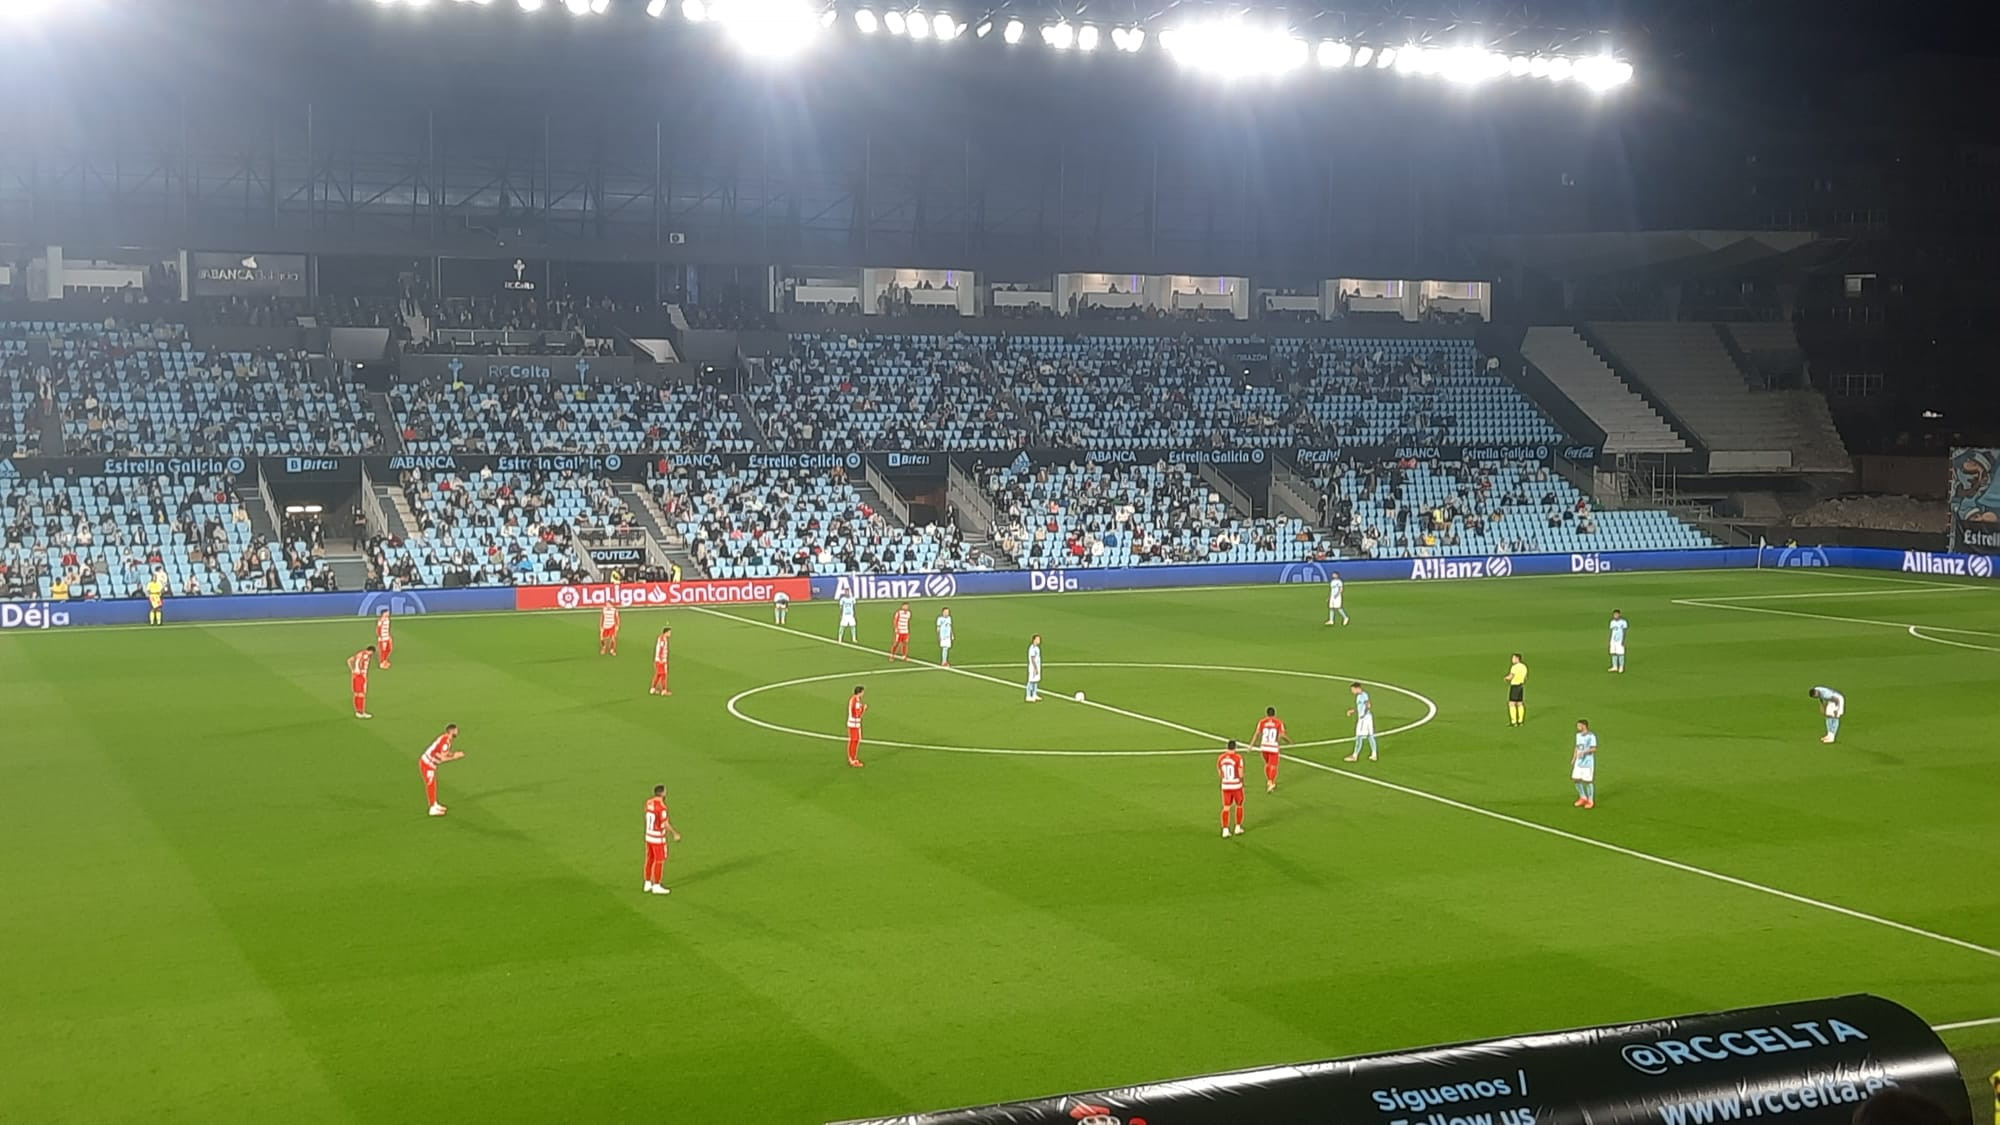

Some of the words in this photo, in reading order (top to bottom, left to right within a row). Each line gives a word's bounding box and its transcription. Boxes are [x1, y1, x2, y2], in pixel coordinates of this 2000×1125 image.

[498, 456, 551, 470] Estrla
[553, 456, 602, 471] Galiia
[748, 454, 797, 468] Estrella
[1168, 450, 1210, 463] Estrella
[1211, 449, 1250, 463] Galicia
[104, 458, 165, 474] Estrella
[1411, 558, 1484, 580] Allianz
[1903, 551, 1965, 575] Allianz
[582, 584, 649, 607] LaLiga
[669, 582, 773, 602] Santander
[834, 574, 921, 600] Allianz
[1622, 1018, 1868, 1075] @RCCELTA
[1390, 1112, 1494, 1125] llow
